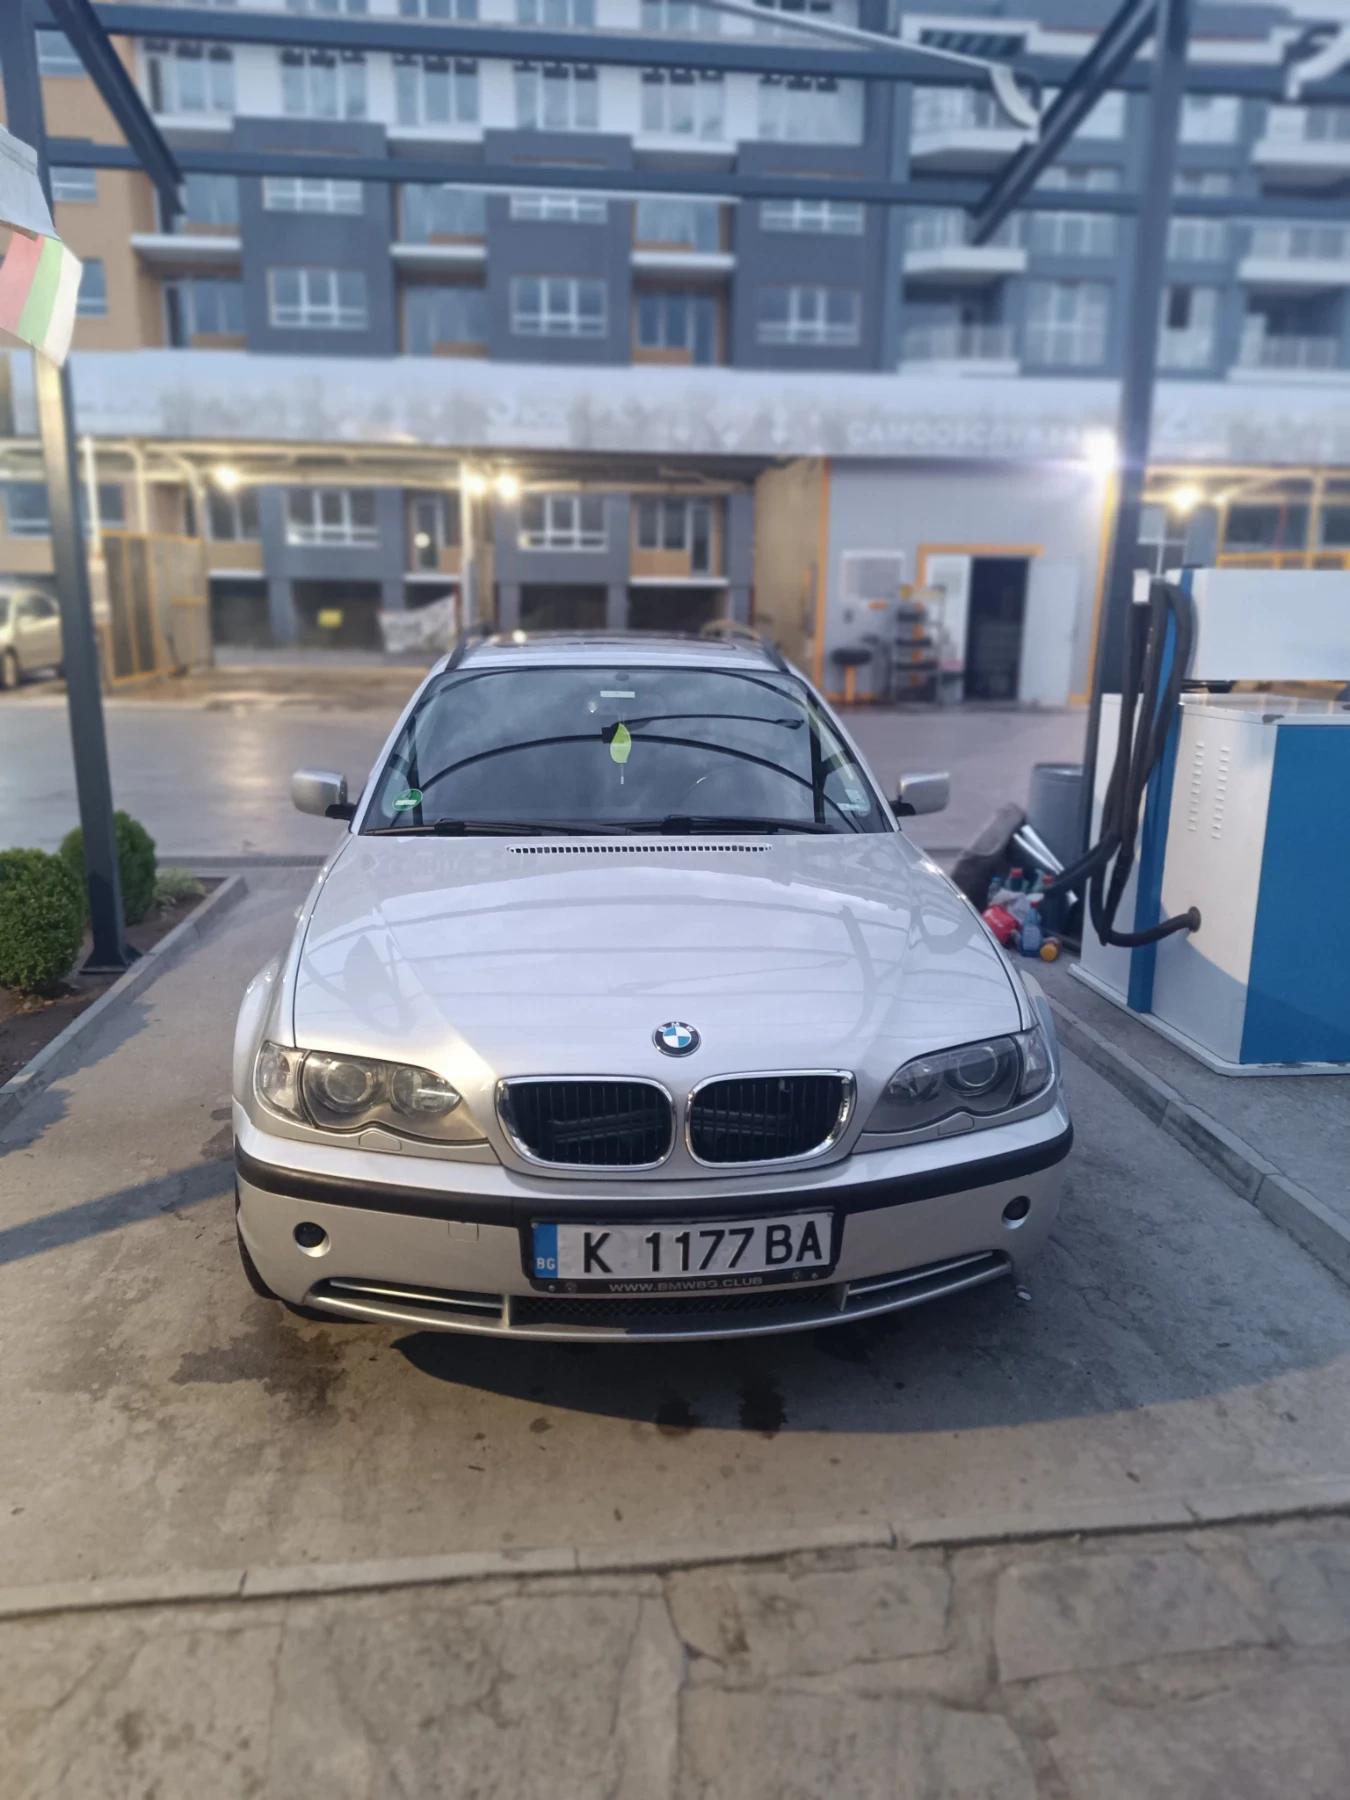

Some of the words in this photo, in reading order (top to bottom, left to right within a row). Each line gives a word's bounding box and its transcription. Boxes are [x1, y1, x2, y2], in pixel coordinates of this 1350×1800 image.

[583, 1231, 613, 1274] K
[645, 1227, 755, 1272] 1177
[765, 1220, 822, 1266] BA
[536, 1257, 556, 1270] BG
[608, 1276, 764, 1292] WWW.BMWBG.CLUB
